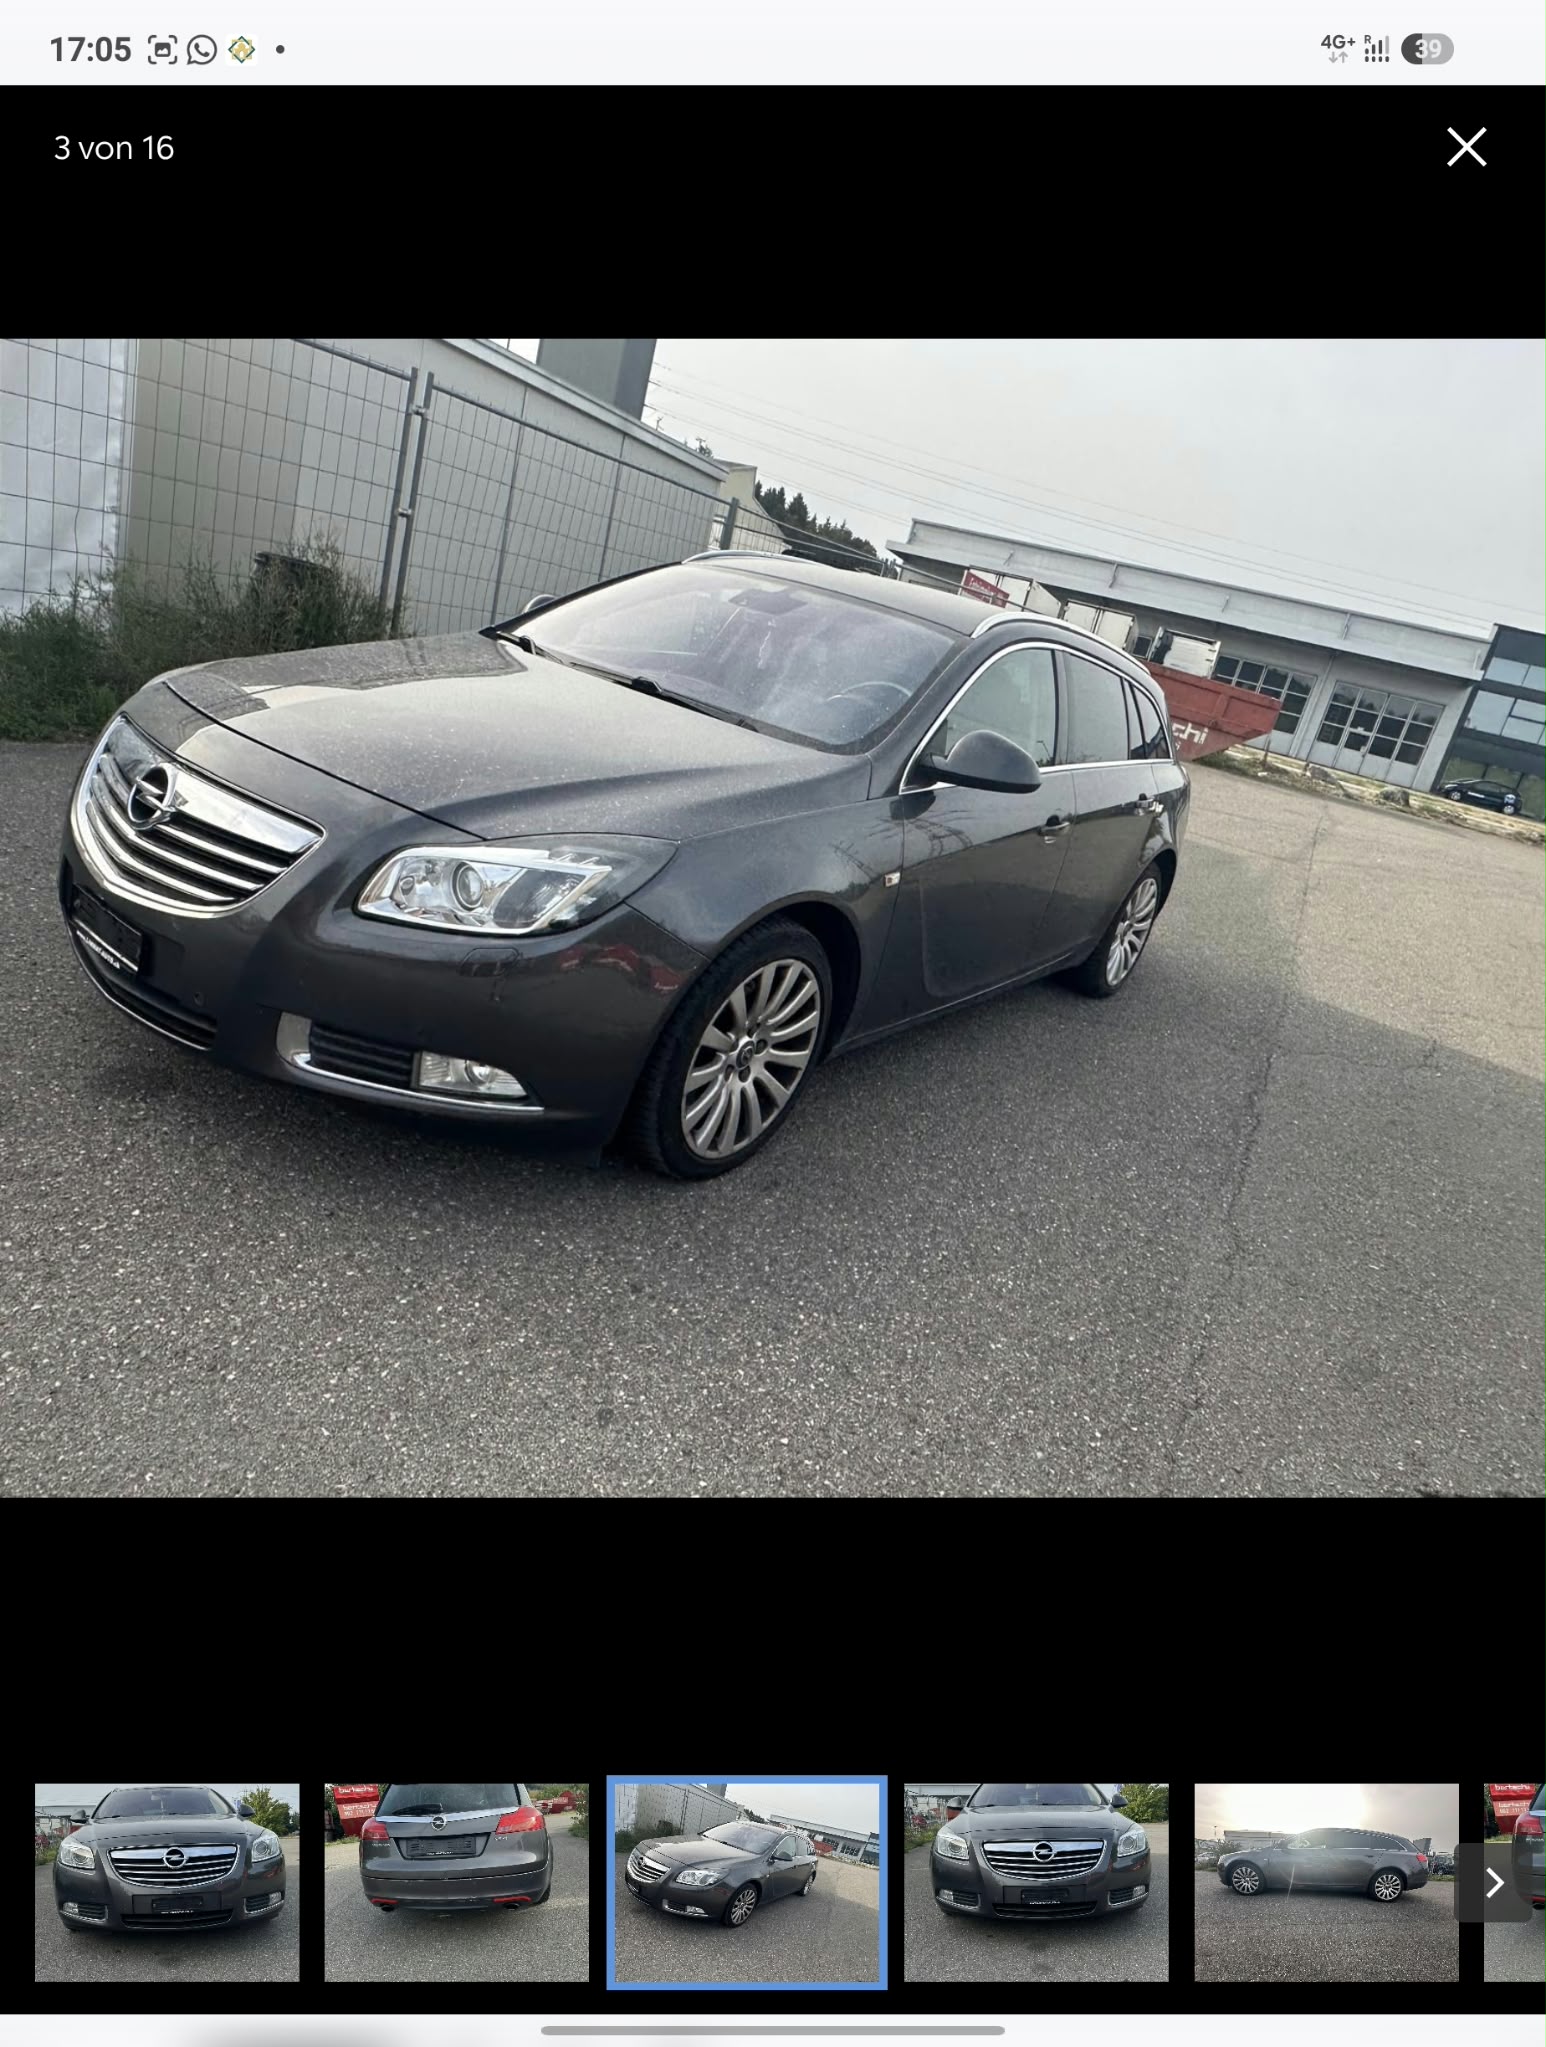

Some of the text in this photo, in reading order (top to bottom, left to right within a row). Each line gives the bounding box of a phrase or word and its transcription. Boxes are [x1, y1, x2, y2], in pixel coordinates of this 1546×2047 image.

[50, 36, 132, 62] 17:05
[1320, 34, 1356, 50] 4G+
[1415, 39, 1442, 59] 39
[54, 134, 175, 161] 3 von 16
